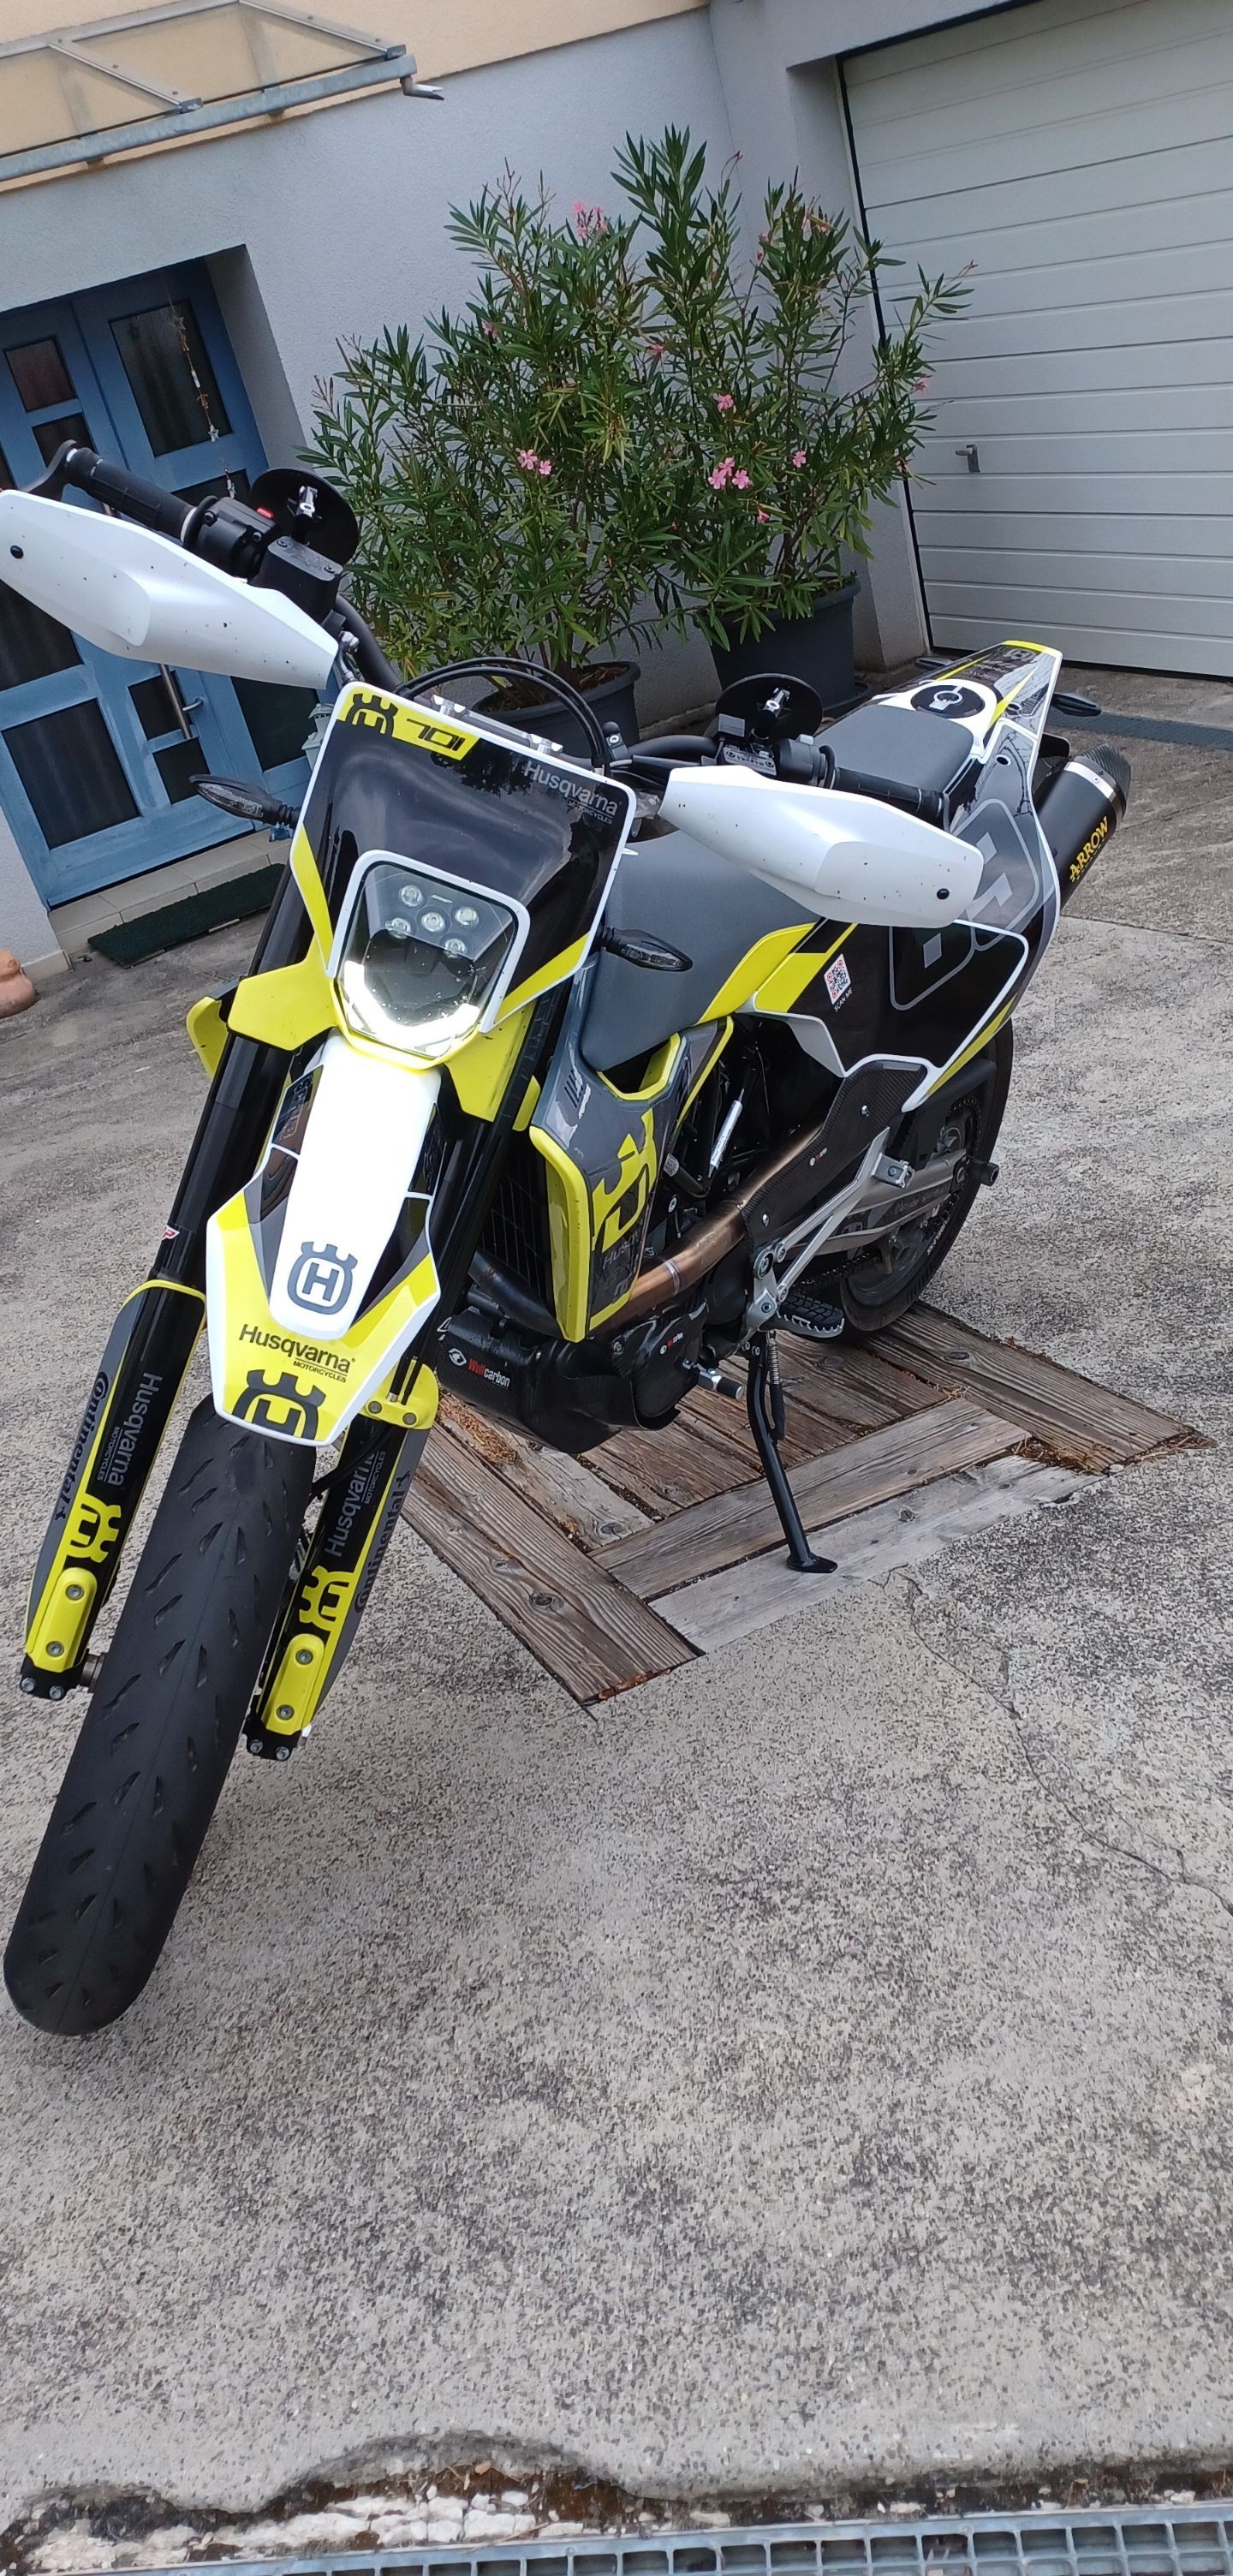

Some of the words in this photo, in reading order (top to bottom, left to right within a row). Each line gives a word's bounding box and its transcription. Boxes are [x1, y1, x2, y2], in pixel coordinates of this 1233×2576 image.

[407, 718, 466, 752] 701
[524, 760, 618, 816] Husqvarna
[566, 800, 613, 825] MOTORCYCLES
[1069, 815, 1108, 883] ARROW
[238, 1323, 351, 1374] Husqvarna
[292, 1360, 347, 1383] MOTORCYCLES
[60, 1371, 109, 1505] Continental
[97, 1426, 121, 1482] MOTORCYCLES
[107, 1372, 164, 1487] Husqvarna
[364, 1450, 386, 1505] MOTORCYCLES
